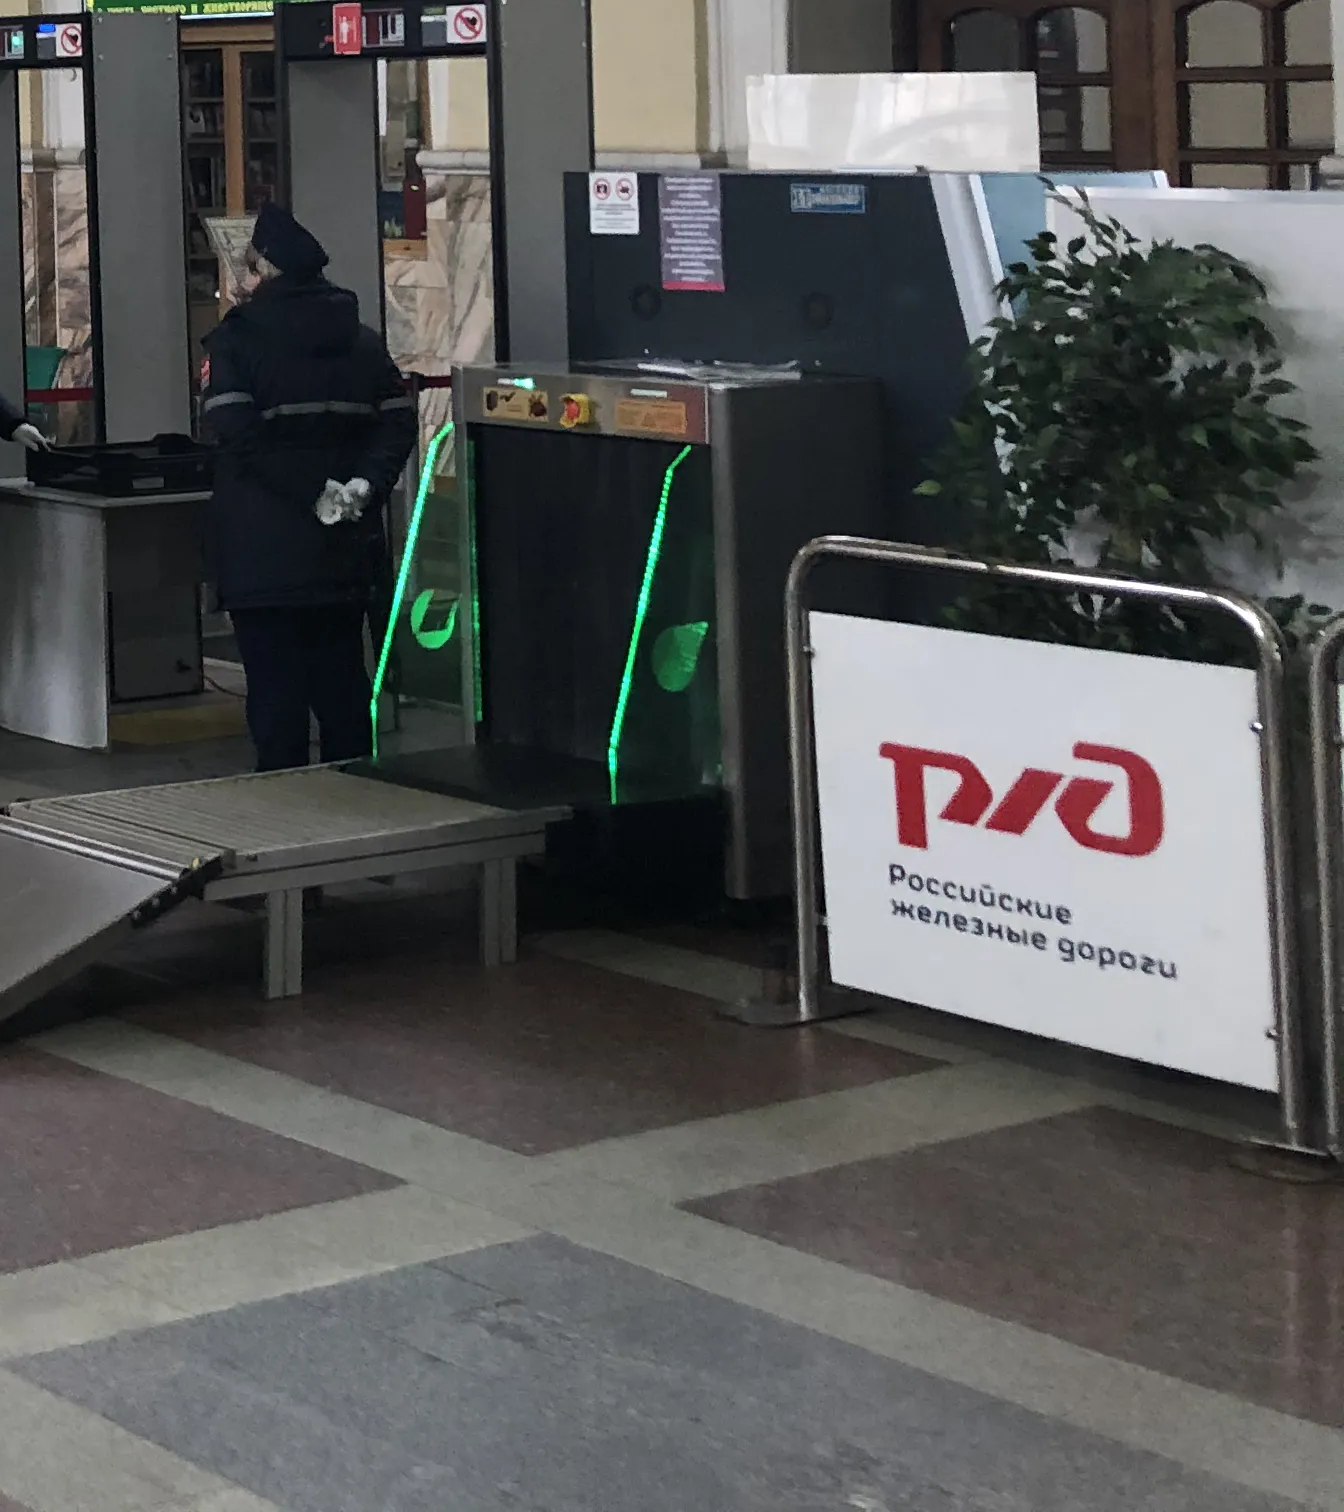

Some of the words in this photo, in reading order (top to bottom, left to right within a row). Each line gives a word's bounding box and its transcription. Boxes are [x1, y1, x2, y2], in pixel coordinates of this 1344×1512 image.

[888, 862, 1073, 925] Российские
[889, 897, 1049, 951] железные
[1057, 936, 1179, 981] дороги
